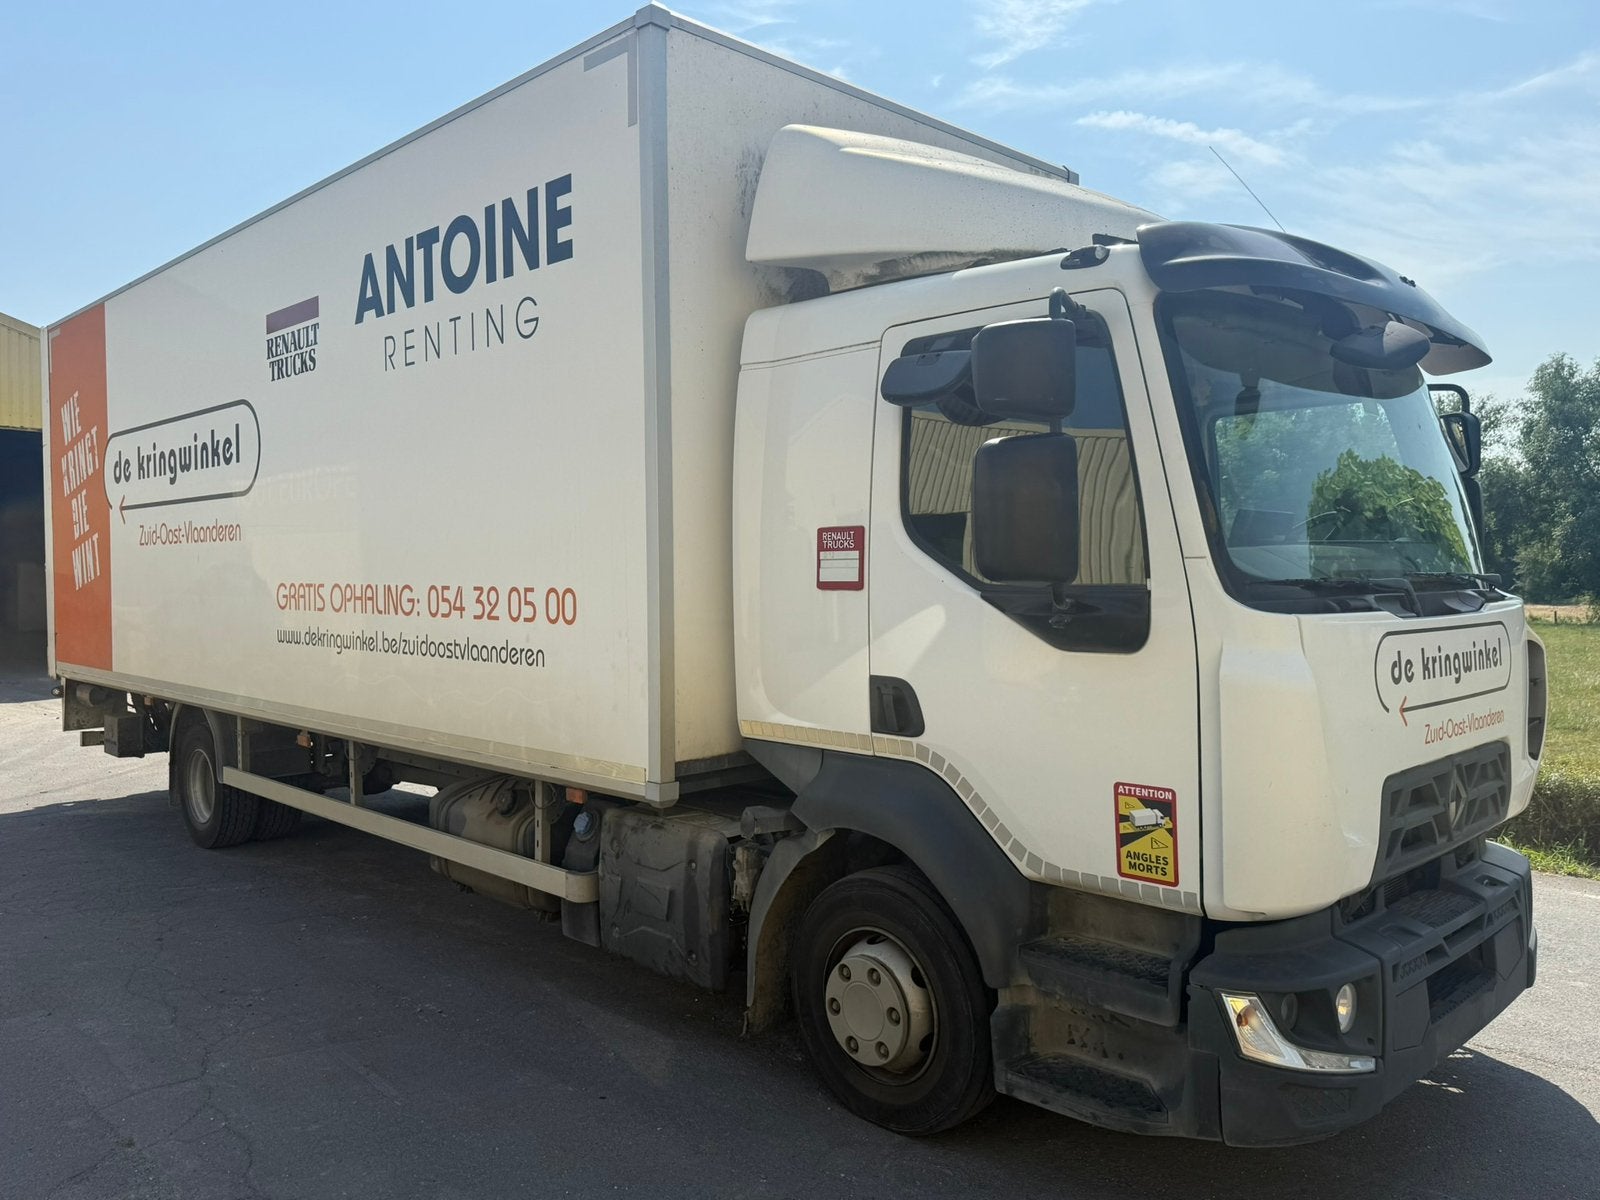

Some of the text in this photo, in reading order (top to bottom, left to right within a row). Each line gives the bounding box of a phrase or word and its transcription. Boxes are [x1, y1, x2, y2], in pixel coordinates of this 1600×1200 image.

[355, 173, 573, 325] ANTOINE
[266, 323, 320, 361] RENAULT
[384, 296, 540, 372] RENTING
[269, 348, 317, 382] TRUCKS
[61, 390, 81, 446] WIE
[61, 425, 99, 498] KRINGT
[113, 423, 241, 486] de kringwinkel
[71, 489, 90, 540] DIE
[139, 518, 242, 547] Zuid-Oost-Vlaanderen
[822, 531, 855, 540] RENAULT
[72, 533, 100, 591] WINT
[822, 539, 855, 548] TRUCKS
[276, 582, 578, 626] GRATIS OPHALING: 054 32 05 00
[276, 625, 546, 668] www.dekringwinkel.be/zuidoostvlaanderen
[1390, 637, 1503, 686] de kringwinkel
[1424, 707, 1505, 745] Zuid-Oost-Vlaanderen
[1118, 785, 1173, 801] ATTENTION
[1125, 850, 1169, 867] ANGLES
[1128, 860, 1168, 877] MORTS
